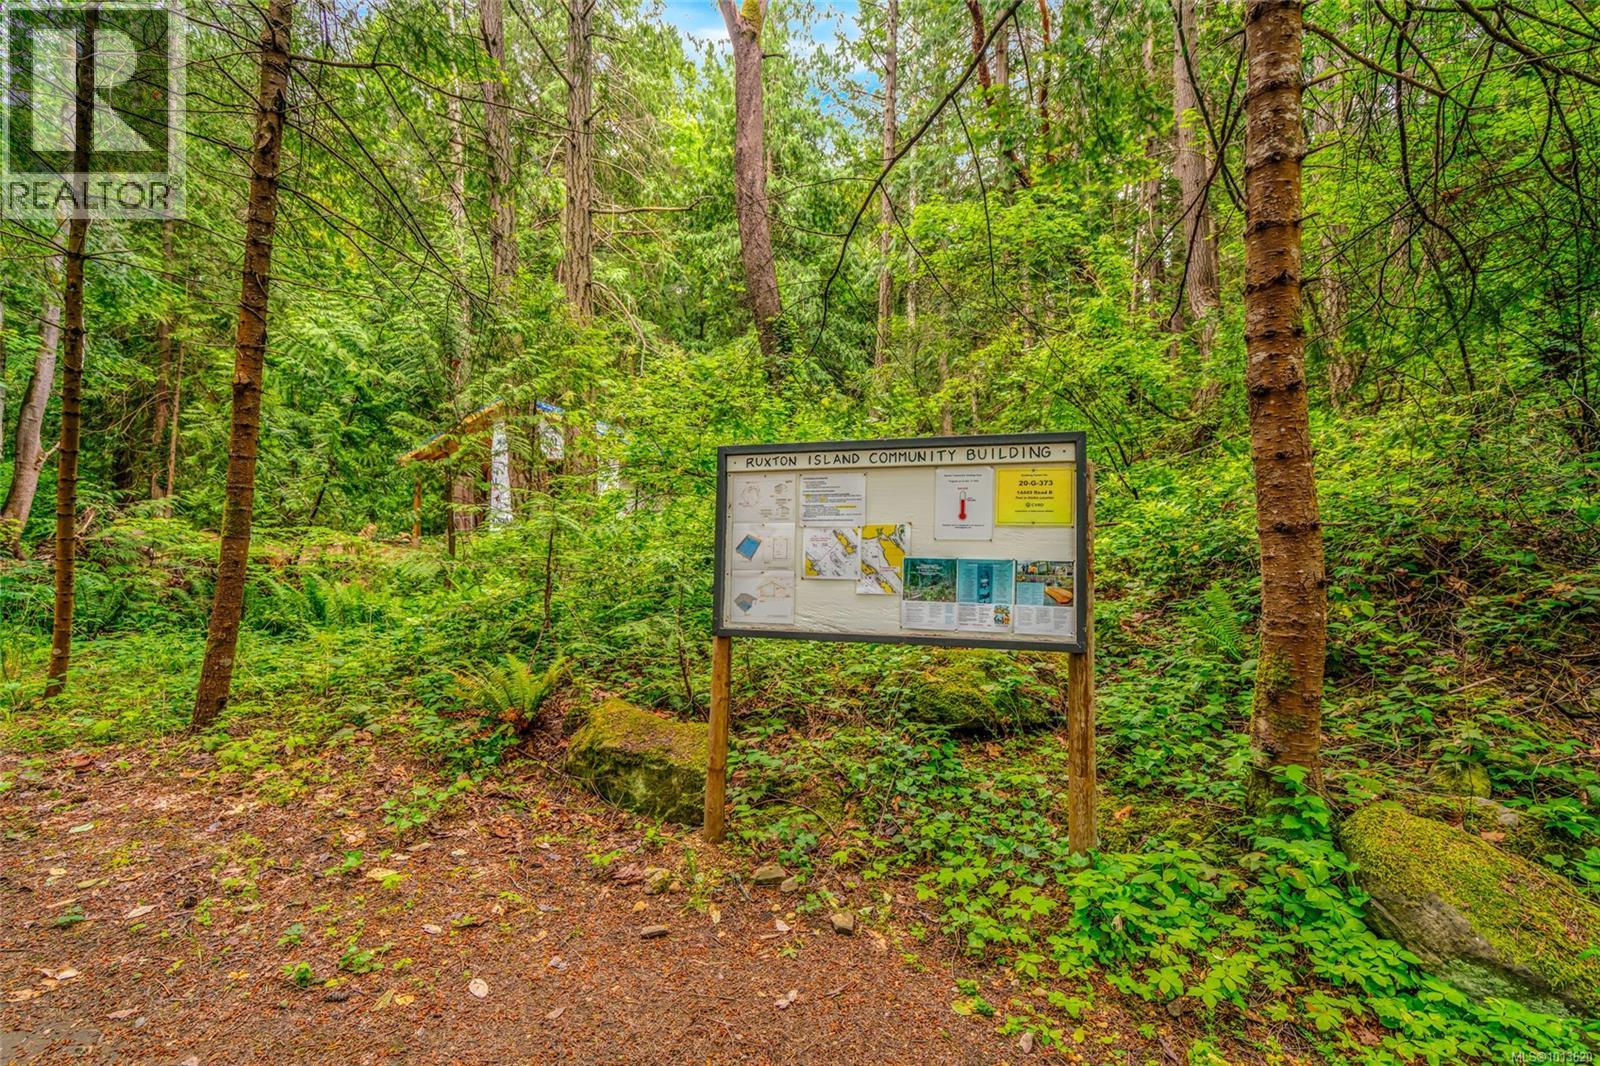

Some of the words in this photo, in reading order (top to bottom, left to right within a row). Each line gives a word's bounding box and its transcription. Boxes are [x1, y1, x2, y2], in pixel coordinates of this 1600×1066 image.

[746, 455, 797, 468] RUXTON
[808, 453, 860, 466] ISLAND
[869, 449, 957, 464] COMMUNITY
[966, 446, 1051, 461] BUILDING
